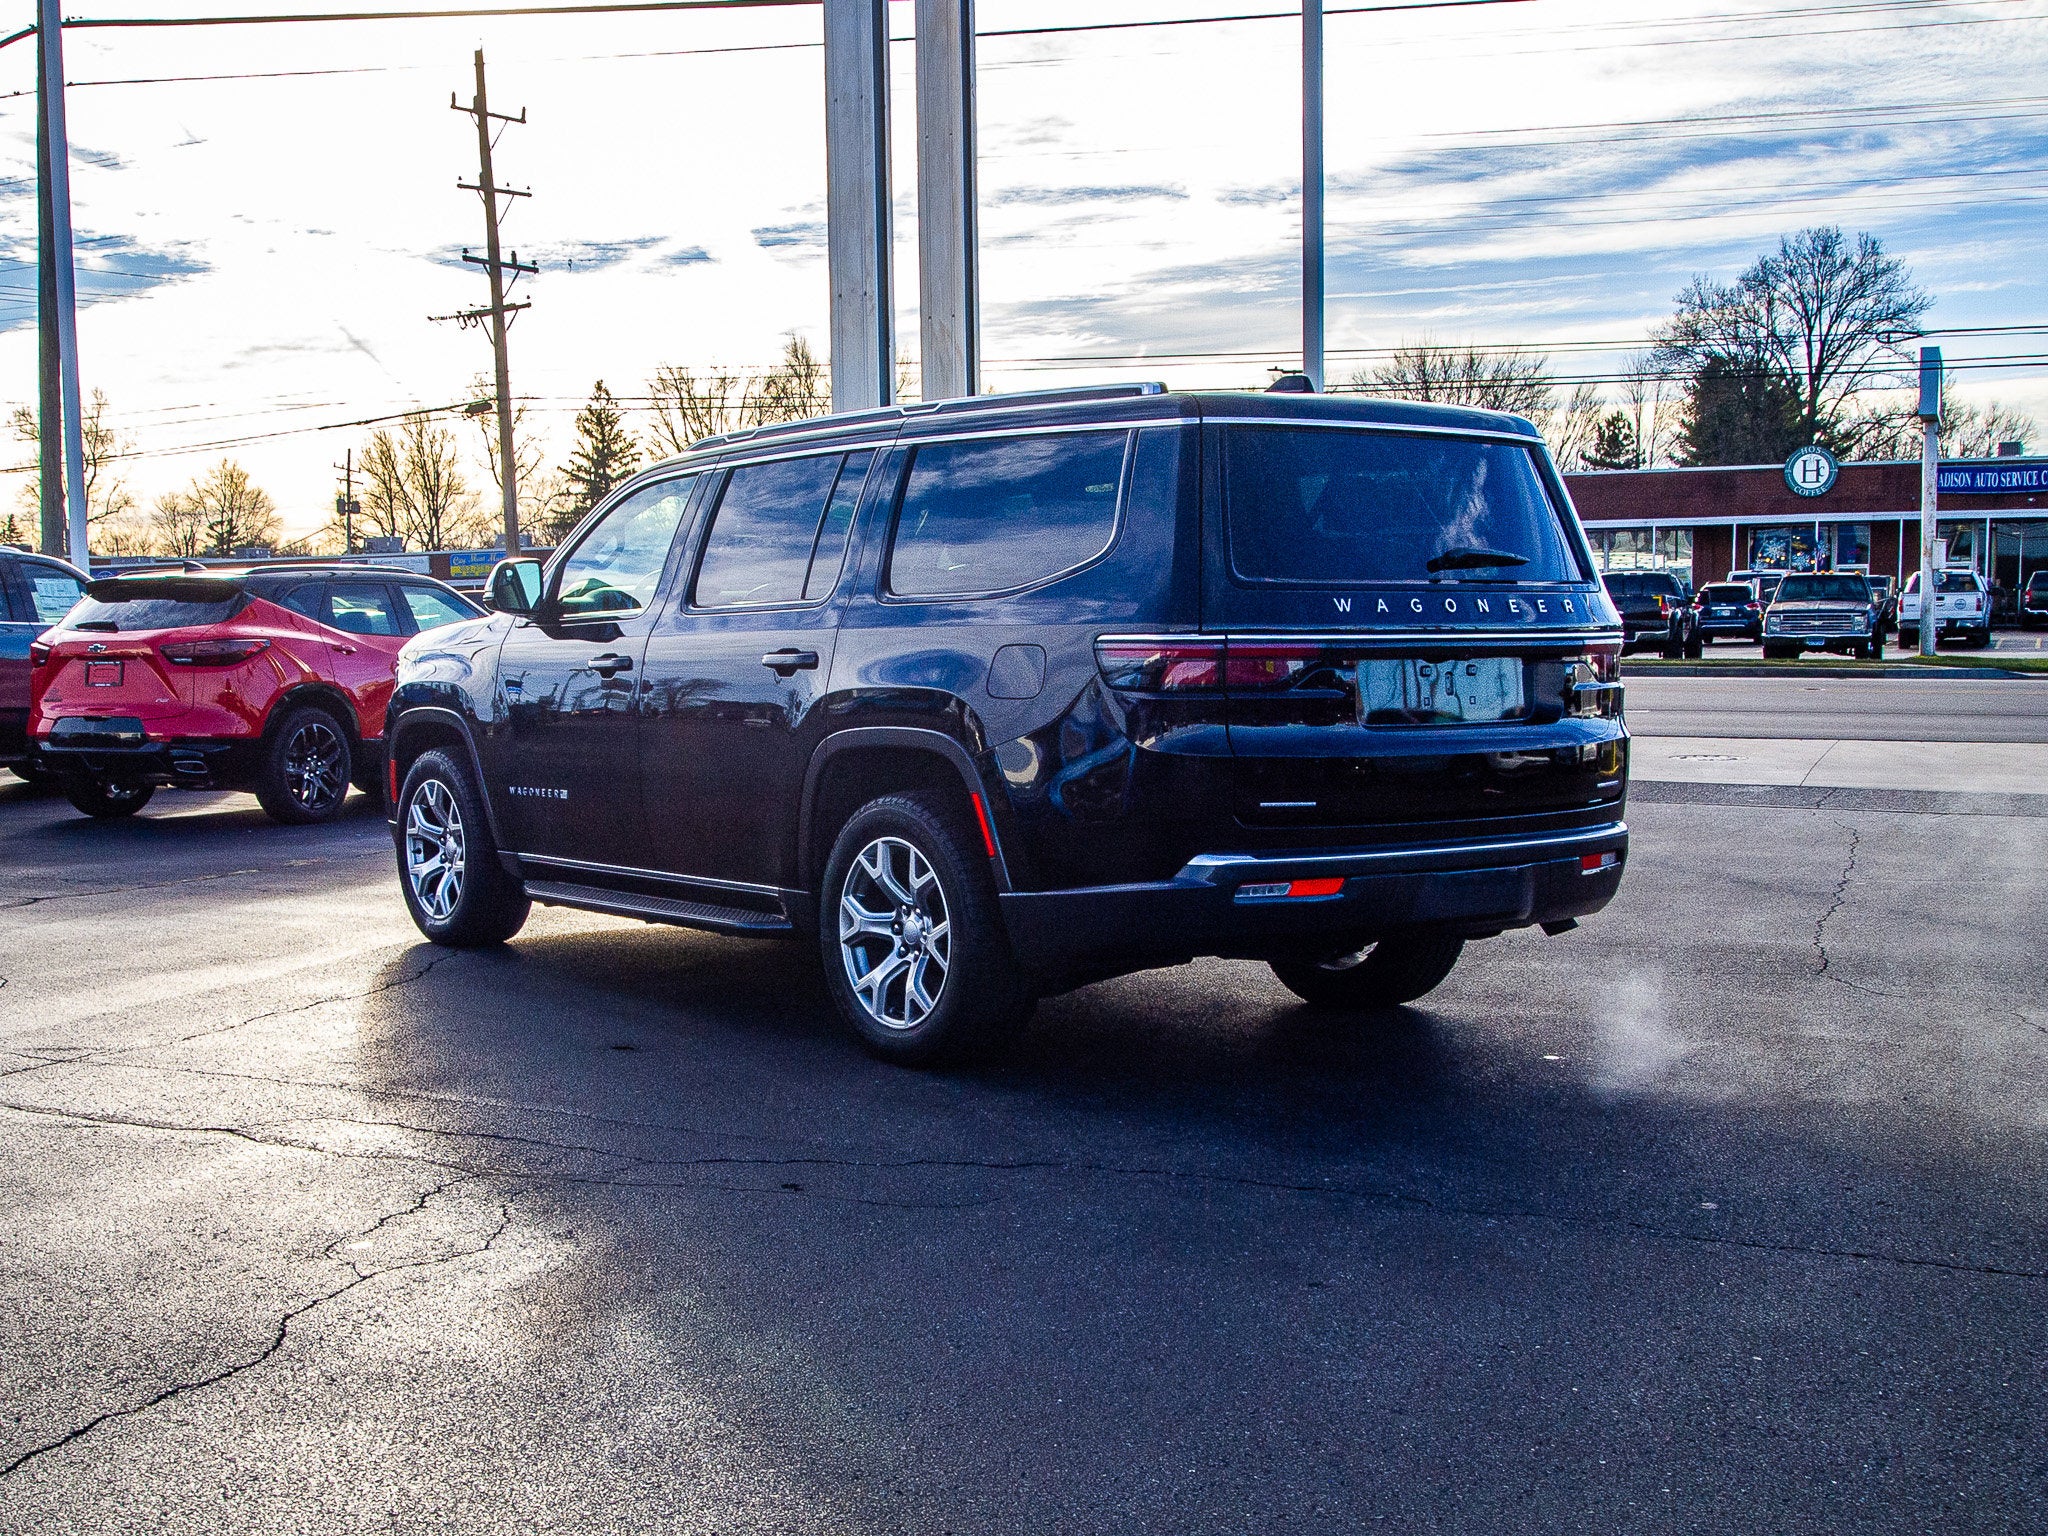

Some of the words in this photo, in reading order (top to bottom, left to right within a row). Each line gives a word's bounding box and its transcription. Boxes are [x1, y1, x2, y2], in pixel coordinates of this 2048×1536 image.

[1800, 446, 1821, 455] HOS
[1936, 472, 1972, 487] ADISON
[1974, 472, 1999, 487] AUTO
[2000, 470, 2039, 487] SERVICE
[1793, 485, 1828, 497] COFFEE
[1333, 598, 1575, 613] WAGONEER
[509, 786, 560, 799] WAGONEER
